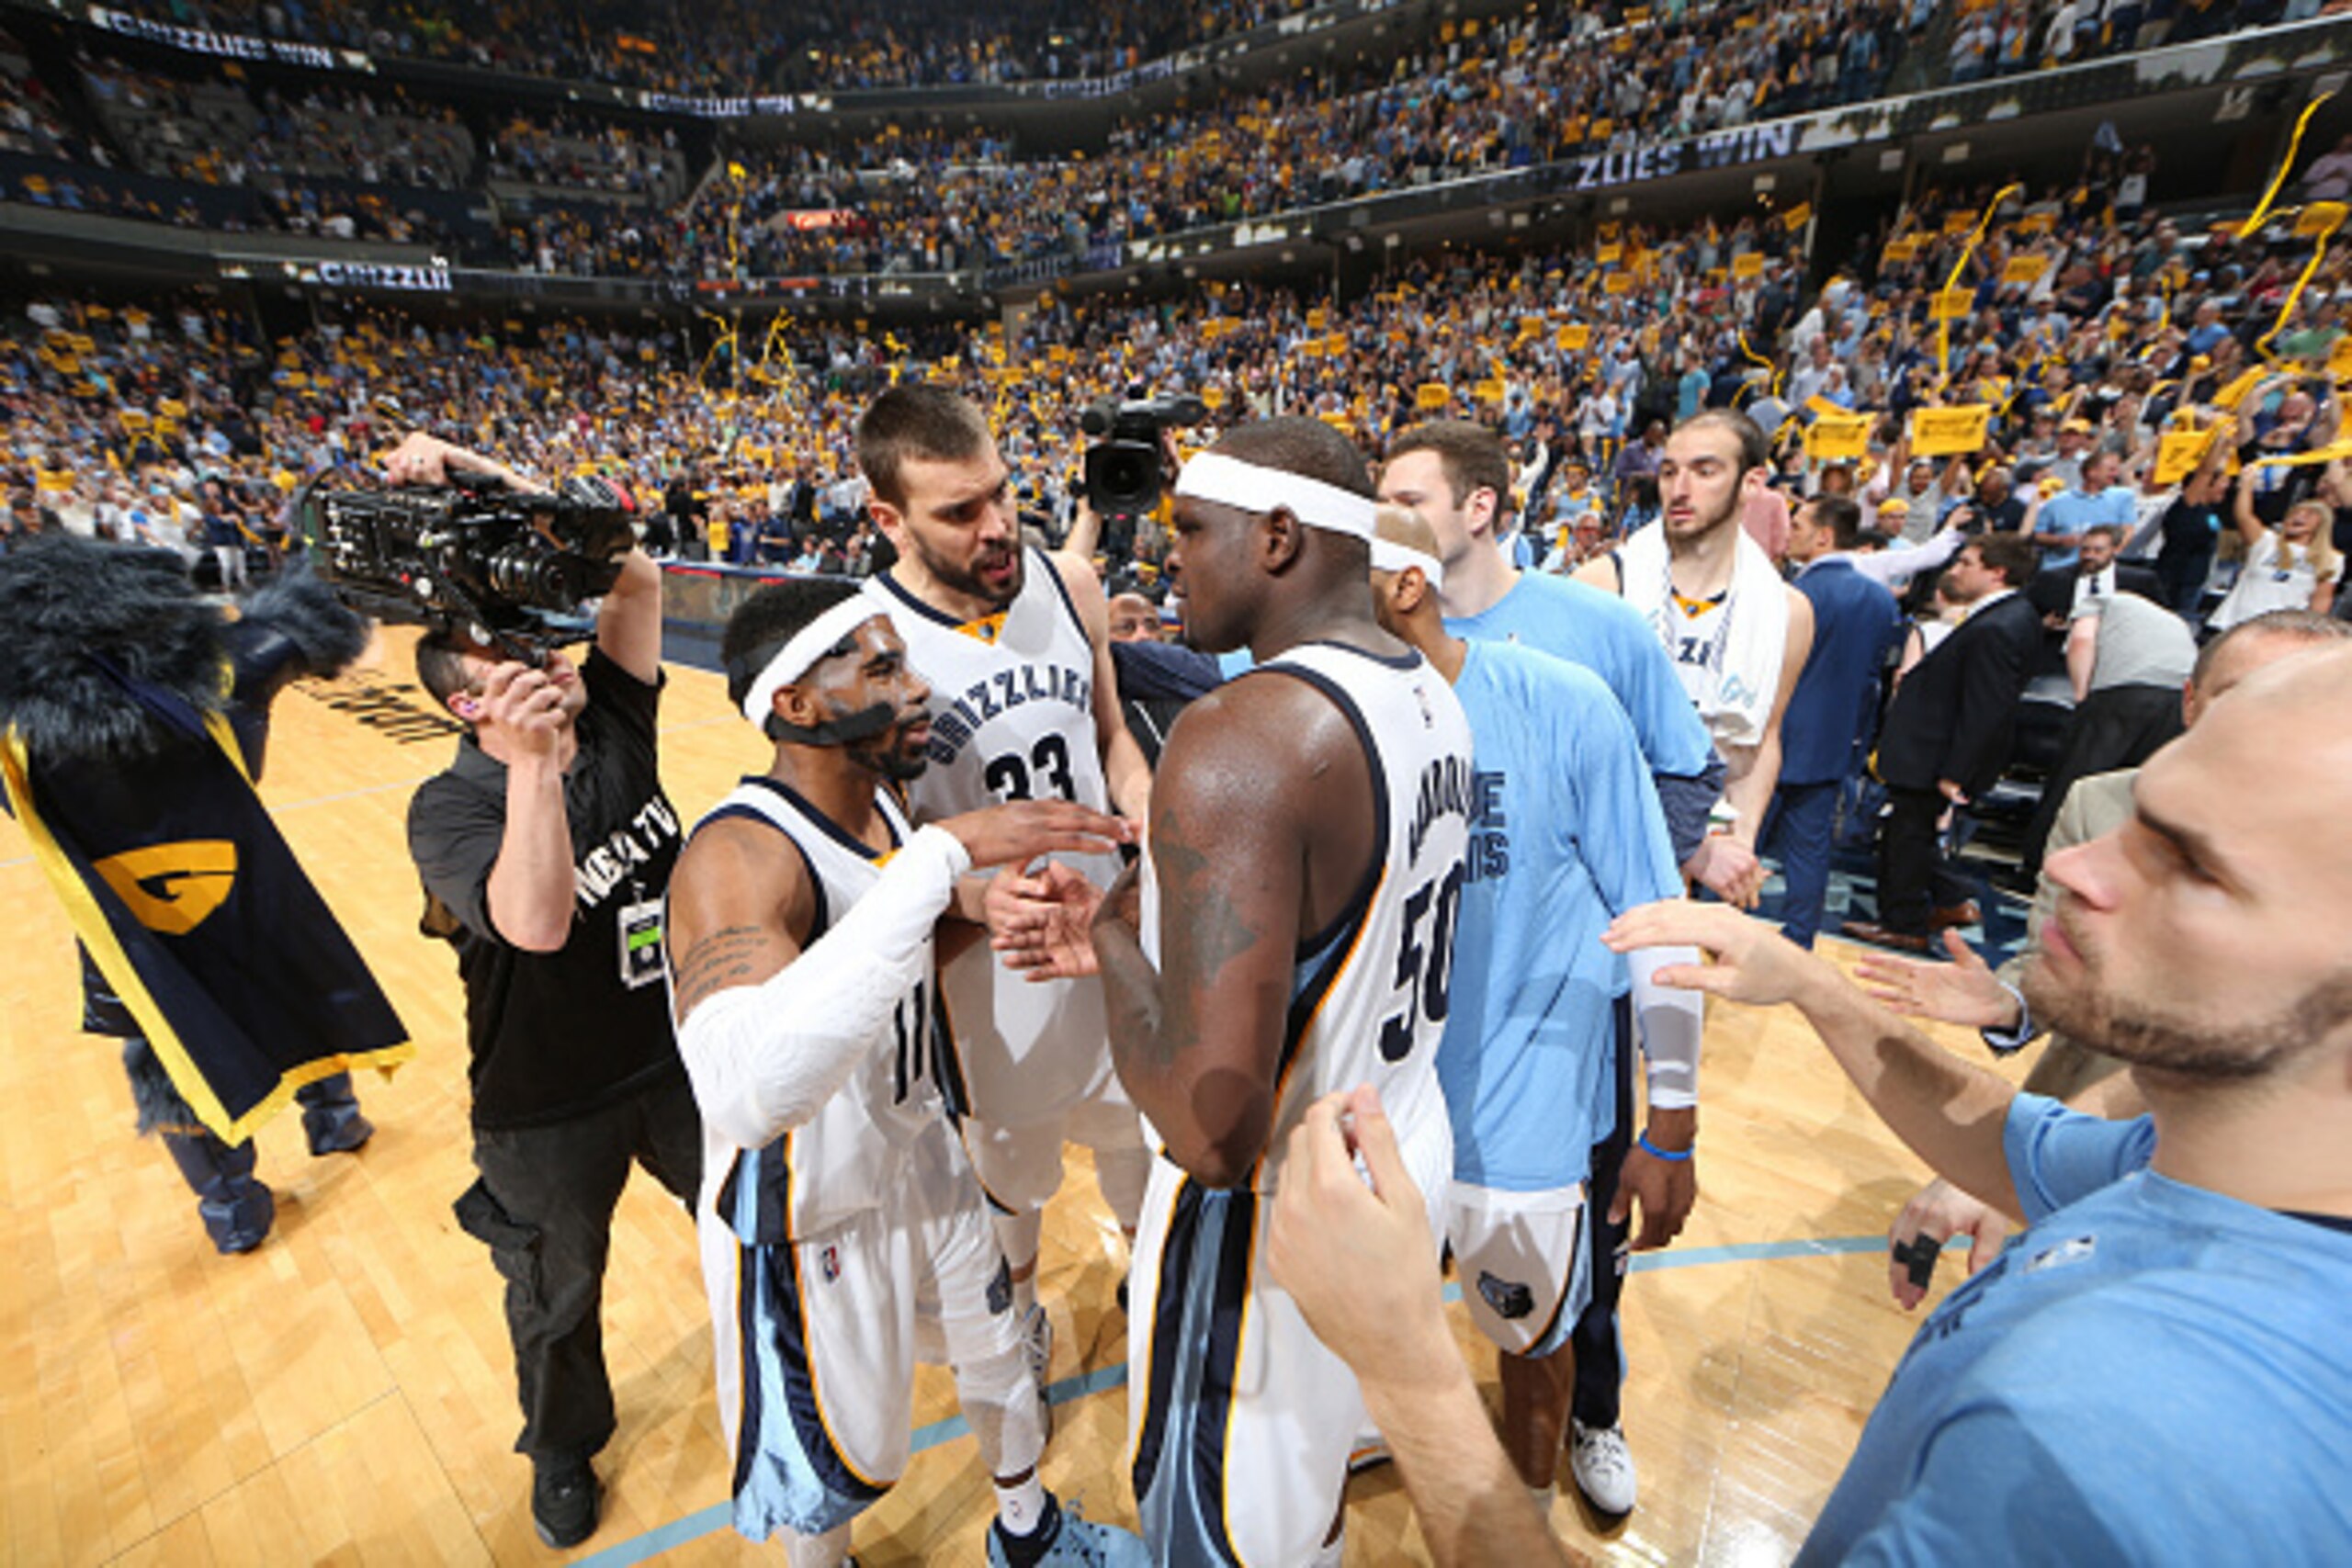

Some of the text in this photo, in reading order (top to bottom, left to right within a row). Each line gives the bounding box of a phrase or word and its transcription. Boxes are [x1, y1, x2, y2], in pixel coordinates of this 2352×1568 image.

[273, 40, 334, 69] WIN
[1696, 124, 1792, 168] WIN
[1378, 859, 1465, 1063] 50
